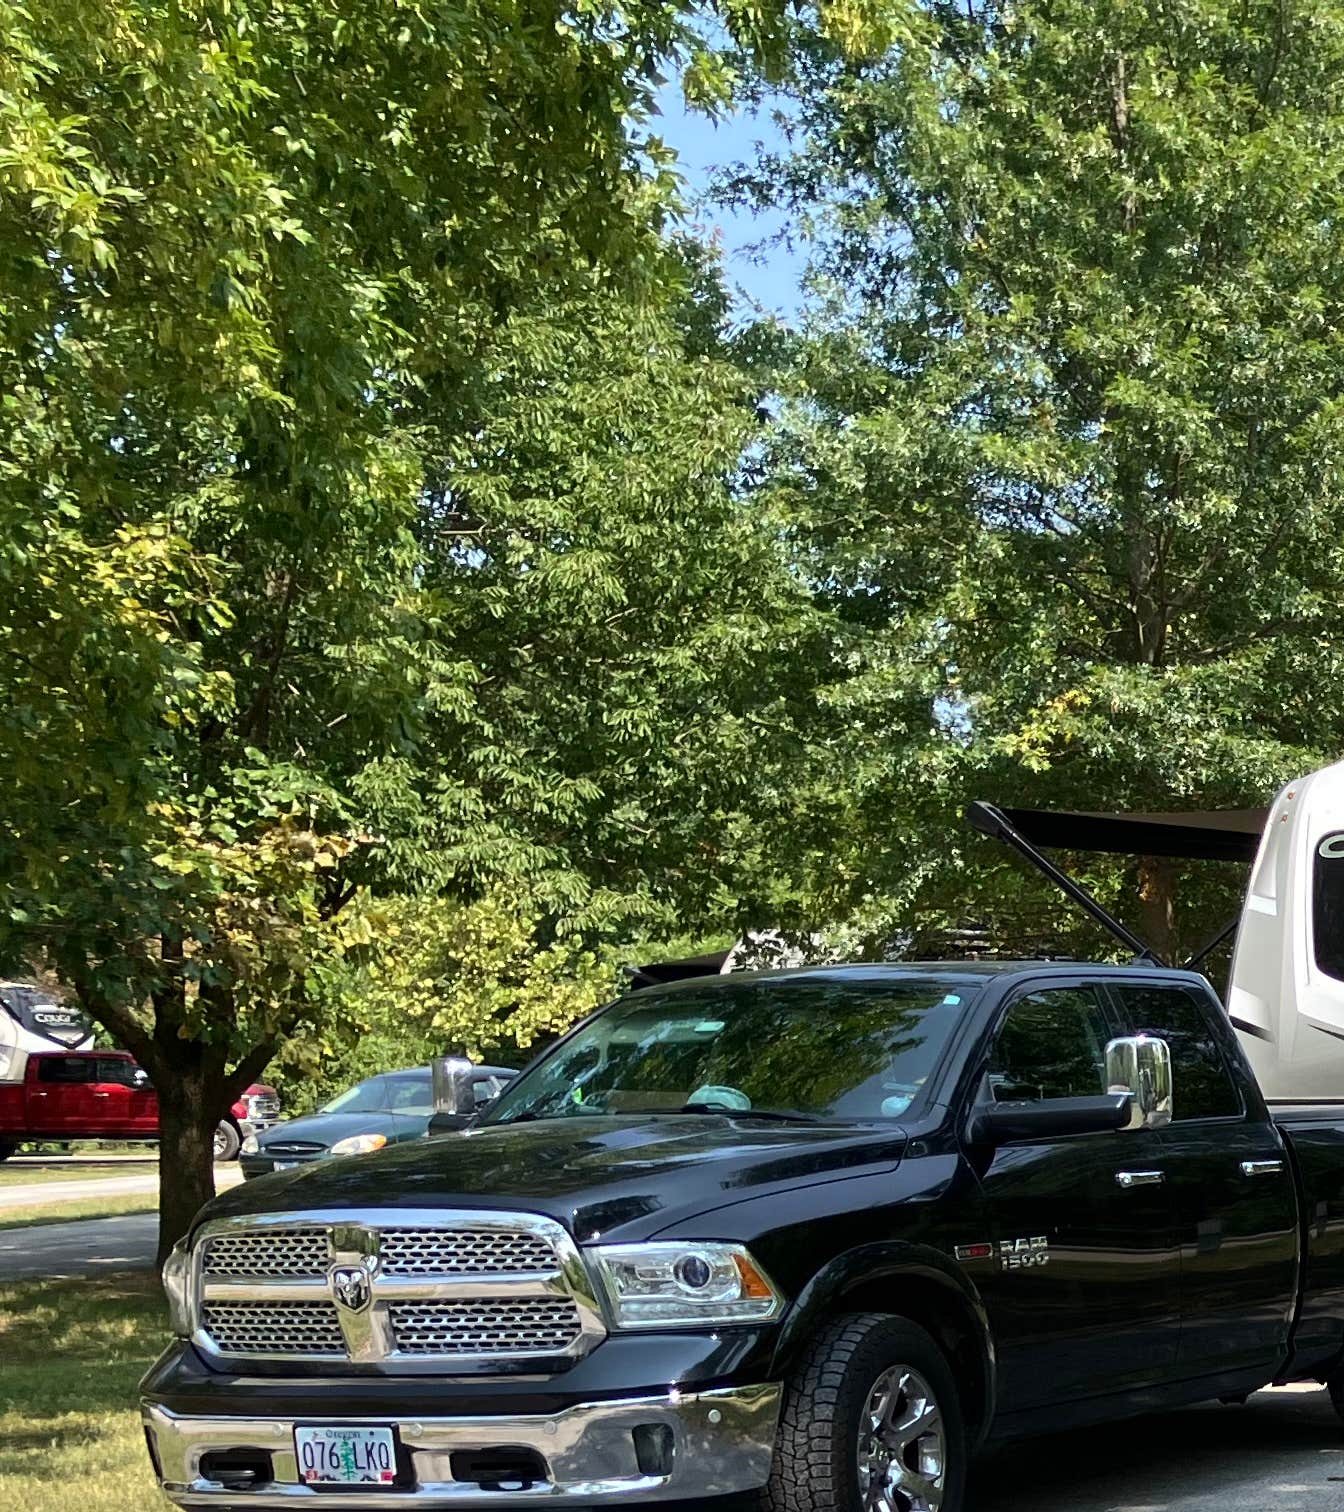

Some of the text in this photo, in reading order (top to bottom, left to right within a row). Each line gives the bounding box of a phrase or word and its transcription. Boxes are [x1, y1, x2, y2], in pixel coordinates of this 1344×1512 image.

[1000, 1236, 1048, 1252] RAM
[1001, 1251, 1049, 1270] 1500
[303, 1442, 340, 1470] 076
